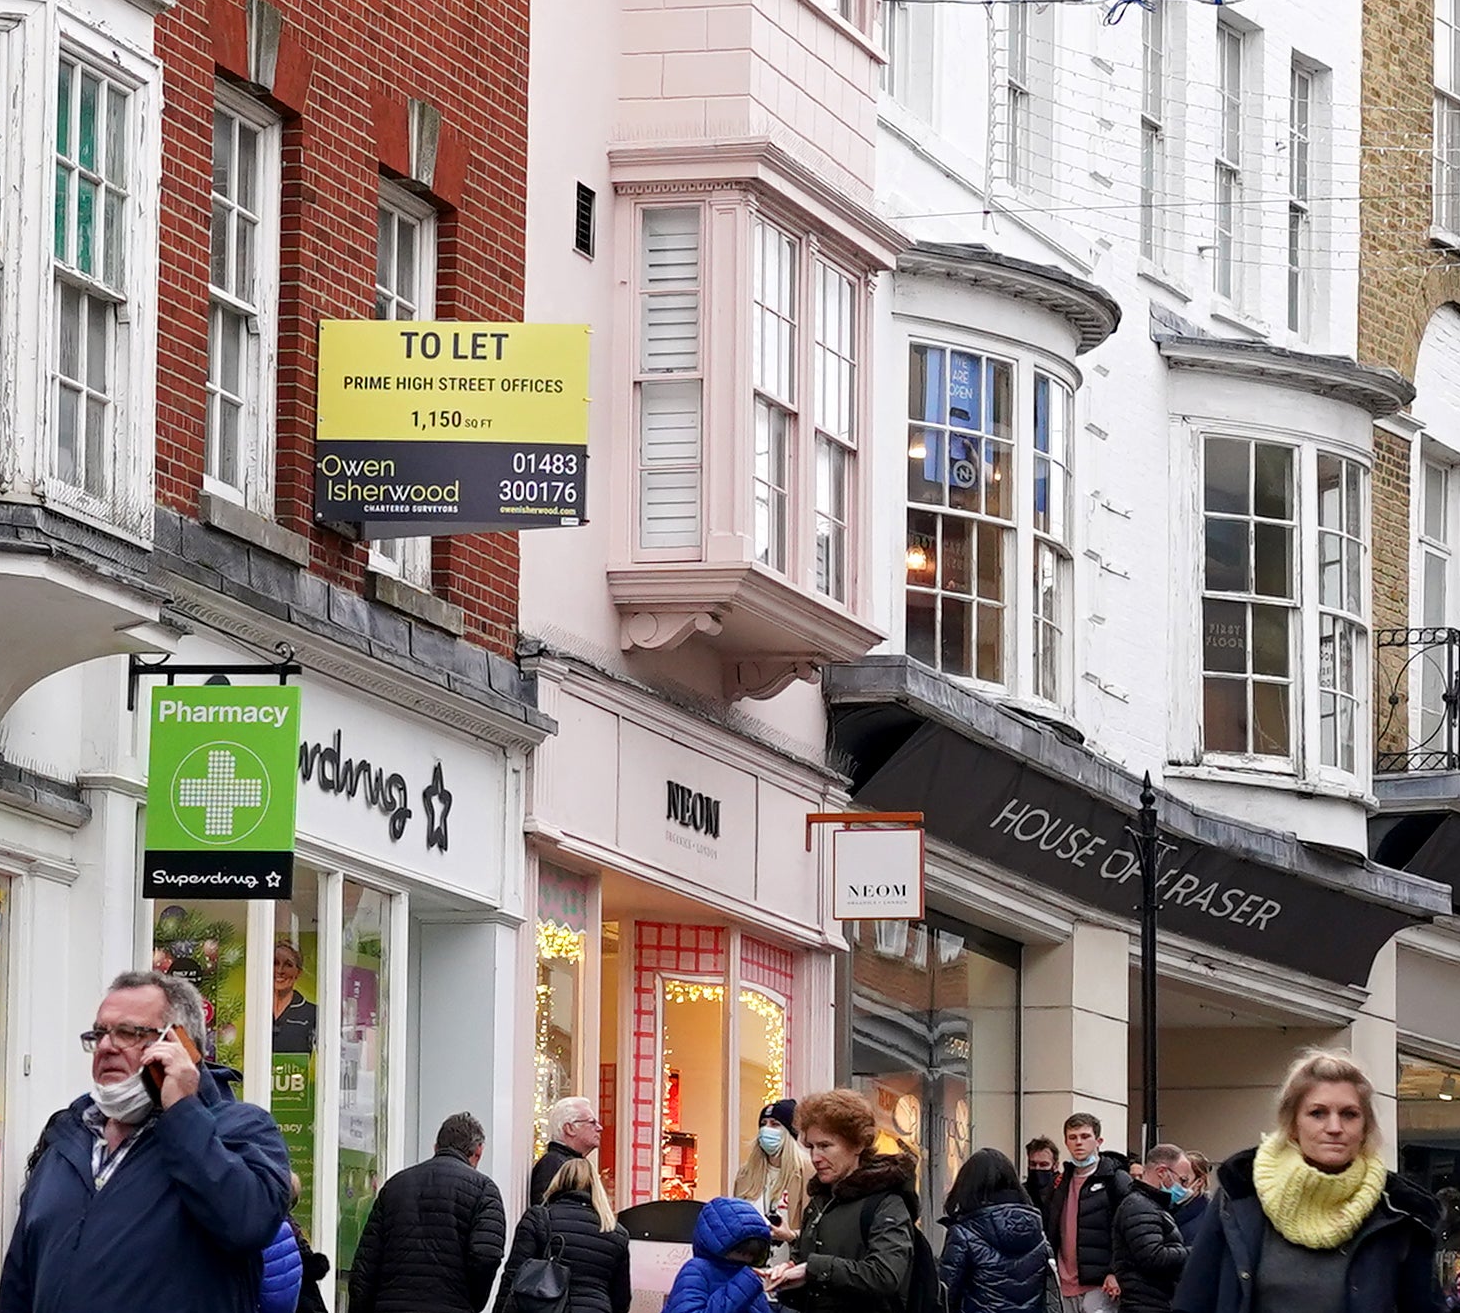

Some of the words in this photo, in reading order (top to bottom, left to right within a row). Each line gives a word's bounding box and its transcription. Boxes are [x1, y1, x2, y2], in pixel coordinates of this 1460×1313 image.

[400, 331, 441, 360] TO
[452, 332, 509, 361] LET
[344, 376, 391, 391] PRIME
[396, 376, 433, 391] HIGH
[439, 377, 496, 392] STREET
[501, 378, 564, 394] OFFICES
[411, 410, 462, 431] 1,150
[464, 418, 478, 429] SQ
[480, 419, 493, 428] FT
[321, 454, 395, 477] Owen
[512, 453, 578, 475] 01483
[327, 479, 460, 503] Isherwood
[498, 480, 577, 504] 300176
[364, 505, 410, 513] CHARTERED
[412, 505, 459, 514] SURVEYORS
[499, 505, 577, 516] owenisherwood.com
[158, 700, 290, 727] Pharmacy
[666, 780, 721, 840] NEOM
[989, 799, 1107, 868] HOUSE
[152, 870, 259, 888] Superdrug
[847, 884, 908, 898] NEOM
